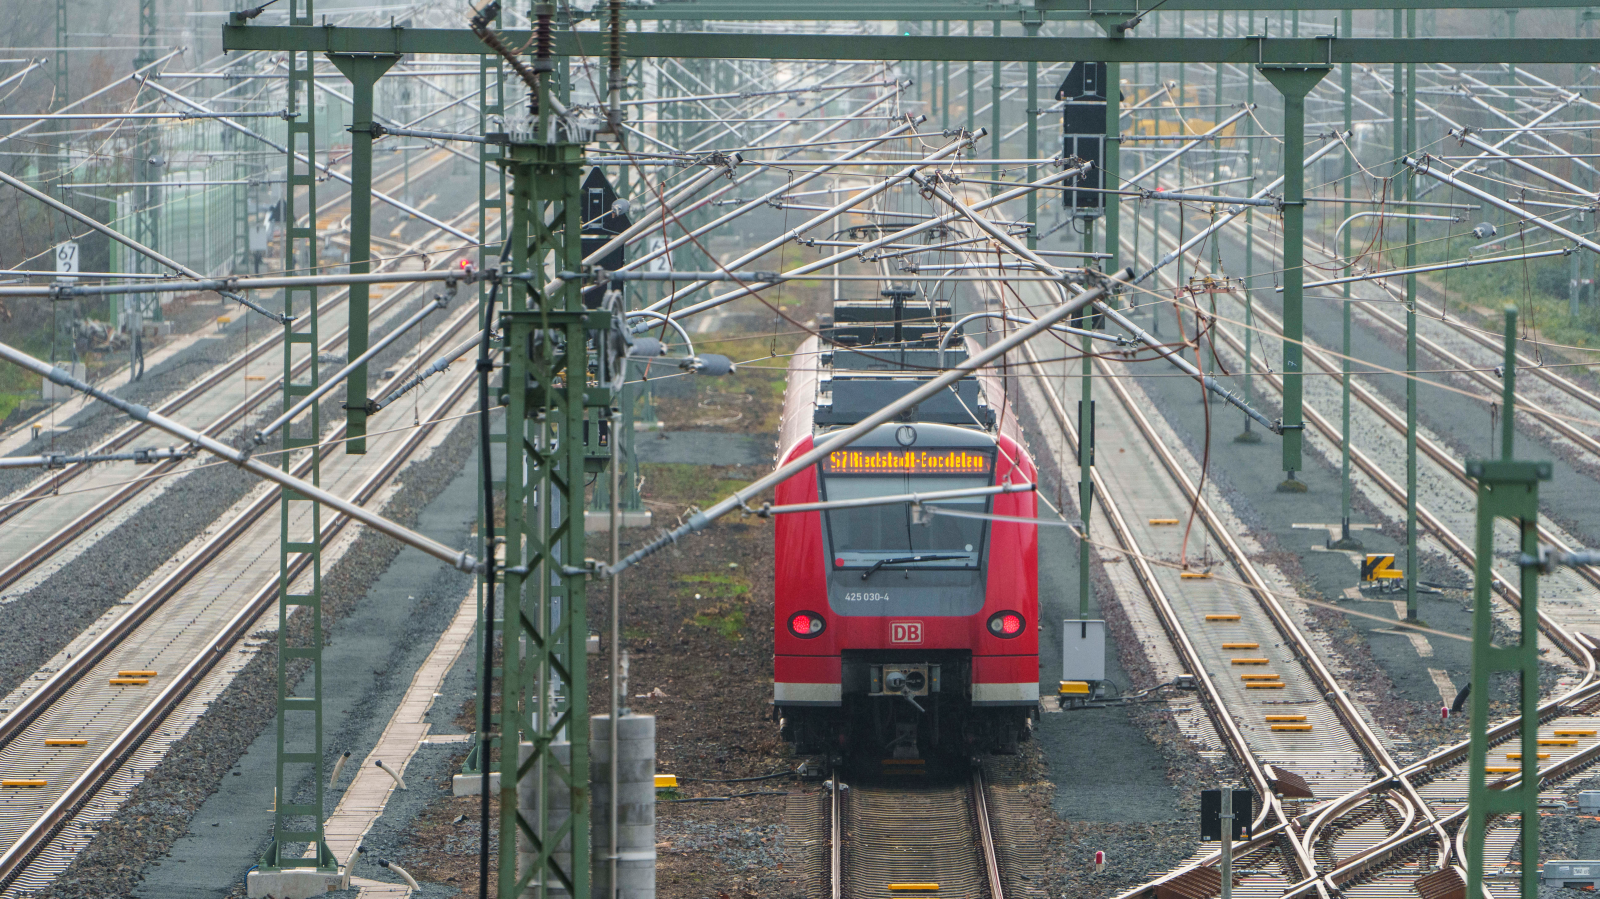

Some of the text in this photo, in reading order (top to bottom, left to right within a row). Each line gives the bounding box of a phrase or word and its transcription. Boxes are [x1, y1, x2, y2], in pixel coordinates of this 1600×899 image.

[58, 245, 76, 260] 67
[657, 256, 666, 270] 2
[830, 451, 848, 468] S7
[845, 592, 890, 602] 425 030-4
[893, 624, 921, 642] DB
